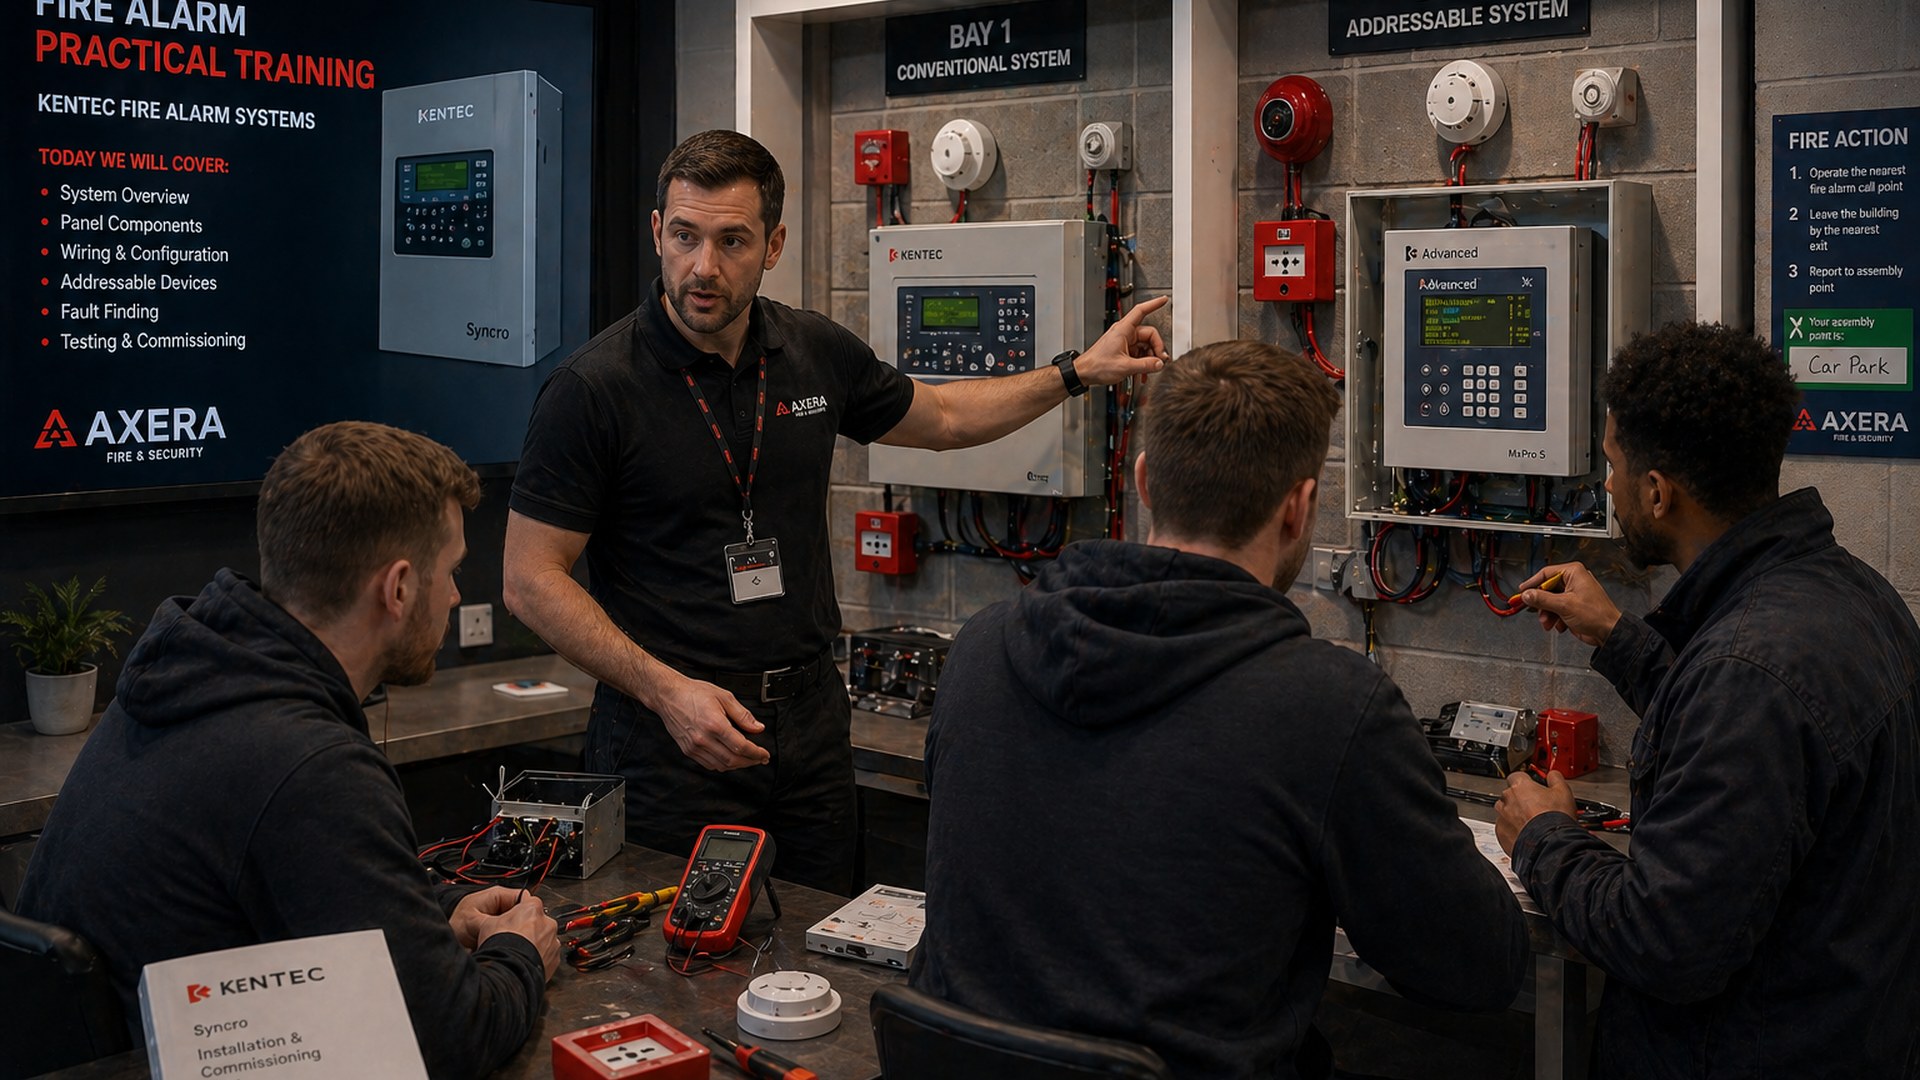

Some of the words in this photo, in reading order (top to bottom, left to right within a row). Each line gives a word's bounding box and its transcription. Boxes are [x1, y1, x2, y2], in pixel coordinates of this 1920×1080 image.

[125, 0, 246, 36] ALARM
[1346, 6, 1483, 38] ADDRESSABLE
[1488, 0, 1569, 25] SYSTEM
[950, 20, 994, 49] BAY
[1000, 18, 1012, 44] 1
[36, 29, 226, 78] PRACTICAL
[234, 49, 375, 89] TRAINING
[897, 56, 1007, 81] CONVENTIONAL
[1010, 48, 1071, 71] SYSTEM
[38, 93, 115, 116] KENTEC
[121, 100, 160, 120] FIRE
[165, 103, 230, 125] ALARM
[235, 108, 316, 130] SYSTEMS
[418, 104, 474, 123] KENTEC
[1789, 131, 1829, 149] FIRE
[1834, 127, 1909, 148] ACTION
[38, 148, 96, 167] TODAY
[100, 151, 126, 168] WE
[129, 153, 168, 171] WILL
[172, 155, 229, 173] COVER:
[1789, 166, 1802, 180] 1.
[1809, 167, 1849, 180] Operate
[1851, 166, 1868, 177] the
[1869, 165, 1906, 176] nearest
[60, 184, 117, 205] System
[121, 186, 190, 205] Overview
[1809, 183, 1826, 194] fire
[1828, 182, 1856, 194] alarm
[1858, 181, 1876, 193] call
[1878, 181, 1903, 194] point
[1788, 207, 1799, 221] 2
[1809, 209, 1838, 220] Leave
[1840, 208, 1857, 219] the
[1859, 207, 1899, 220] building
[60, 214, 104, 231] Panel
[108, 215, 203, 235] Components
[1809, 226, 1822, 238] by
[1824, 225, 1840, 236] the
[1842, 225, 1880, 236] nearest
[60, 243, 111, 264] Wiring
[115, 244, 126, 261] &
[130, 245, 229, 265] Configuration
[901, 249, 943, 260] KENTEC
[1422, 247, 1479, 260] Advanced
[1809, 240, 1828, 251] exit
[1788, 264, 1799, 278] 3
[1809, 266, 1842, 278] Report
[1844, 266, 1854, 276] to
[1856, 265, 1903, 278] assembly
[60, 273, 156, 290] Addressable
[160, 274, 217, 290] Devices
[1809, 283, 1835, 295] point
[60, 303, 100, 319] Fault
[104, 303, 159, 323] Finding
[1809, 317, 1830, 327] Your
[466, 322, 510, 341] Syncro
[60, 333, 117, 353] Testing
[121, 333, 133, 349] &
[136, 332, 246, 350] Commissioning
[1808, 355, 1841, 374] Car
[1849, 355, 1890, 375] Park
[792, 395, 827, 412] AXERA
[84, 406, 226, 446] AXERA
[1821, 411, 1909, 432] AXERA
[107, 451, 133, 463] FIRE
[136, 450, 145, 461] &
[148, 447, 204, 460] SECURITY
[1539, 449, 1546, 460] S
[220, 967, 326, 996] KENTEC
[193, 1019, 248, 1038] Syncro
[198, 1036, 286, 1060] Installation
[290, 1032, 303, 1044] &
[201, 1049, 322, 1078] Commissioning
